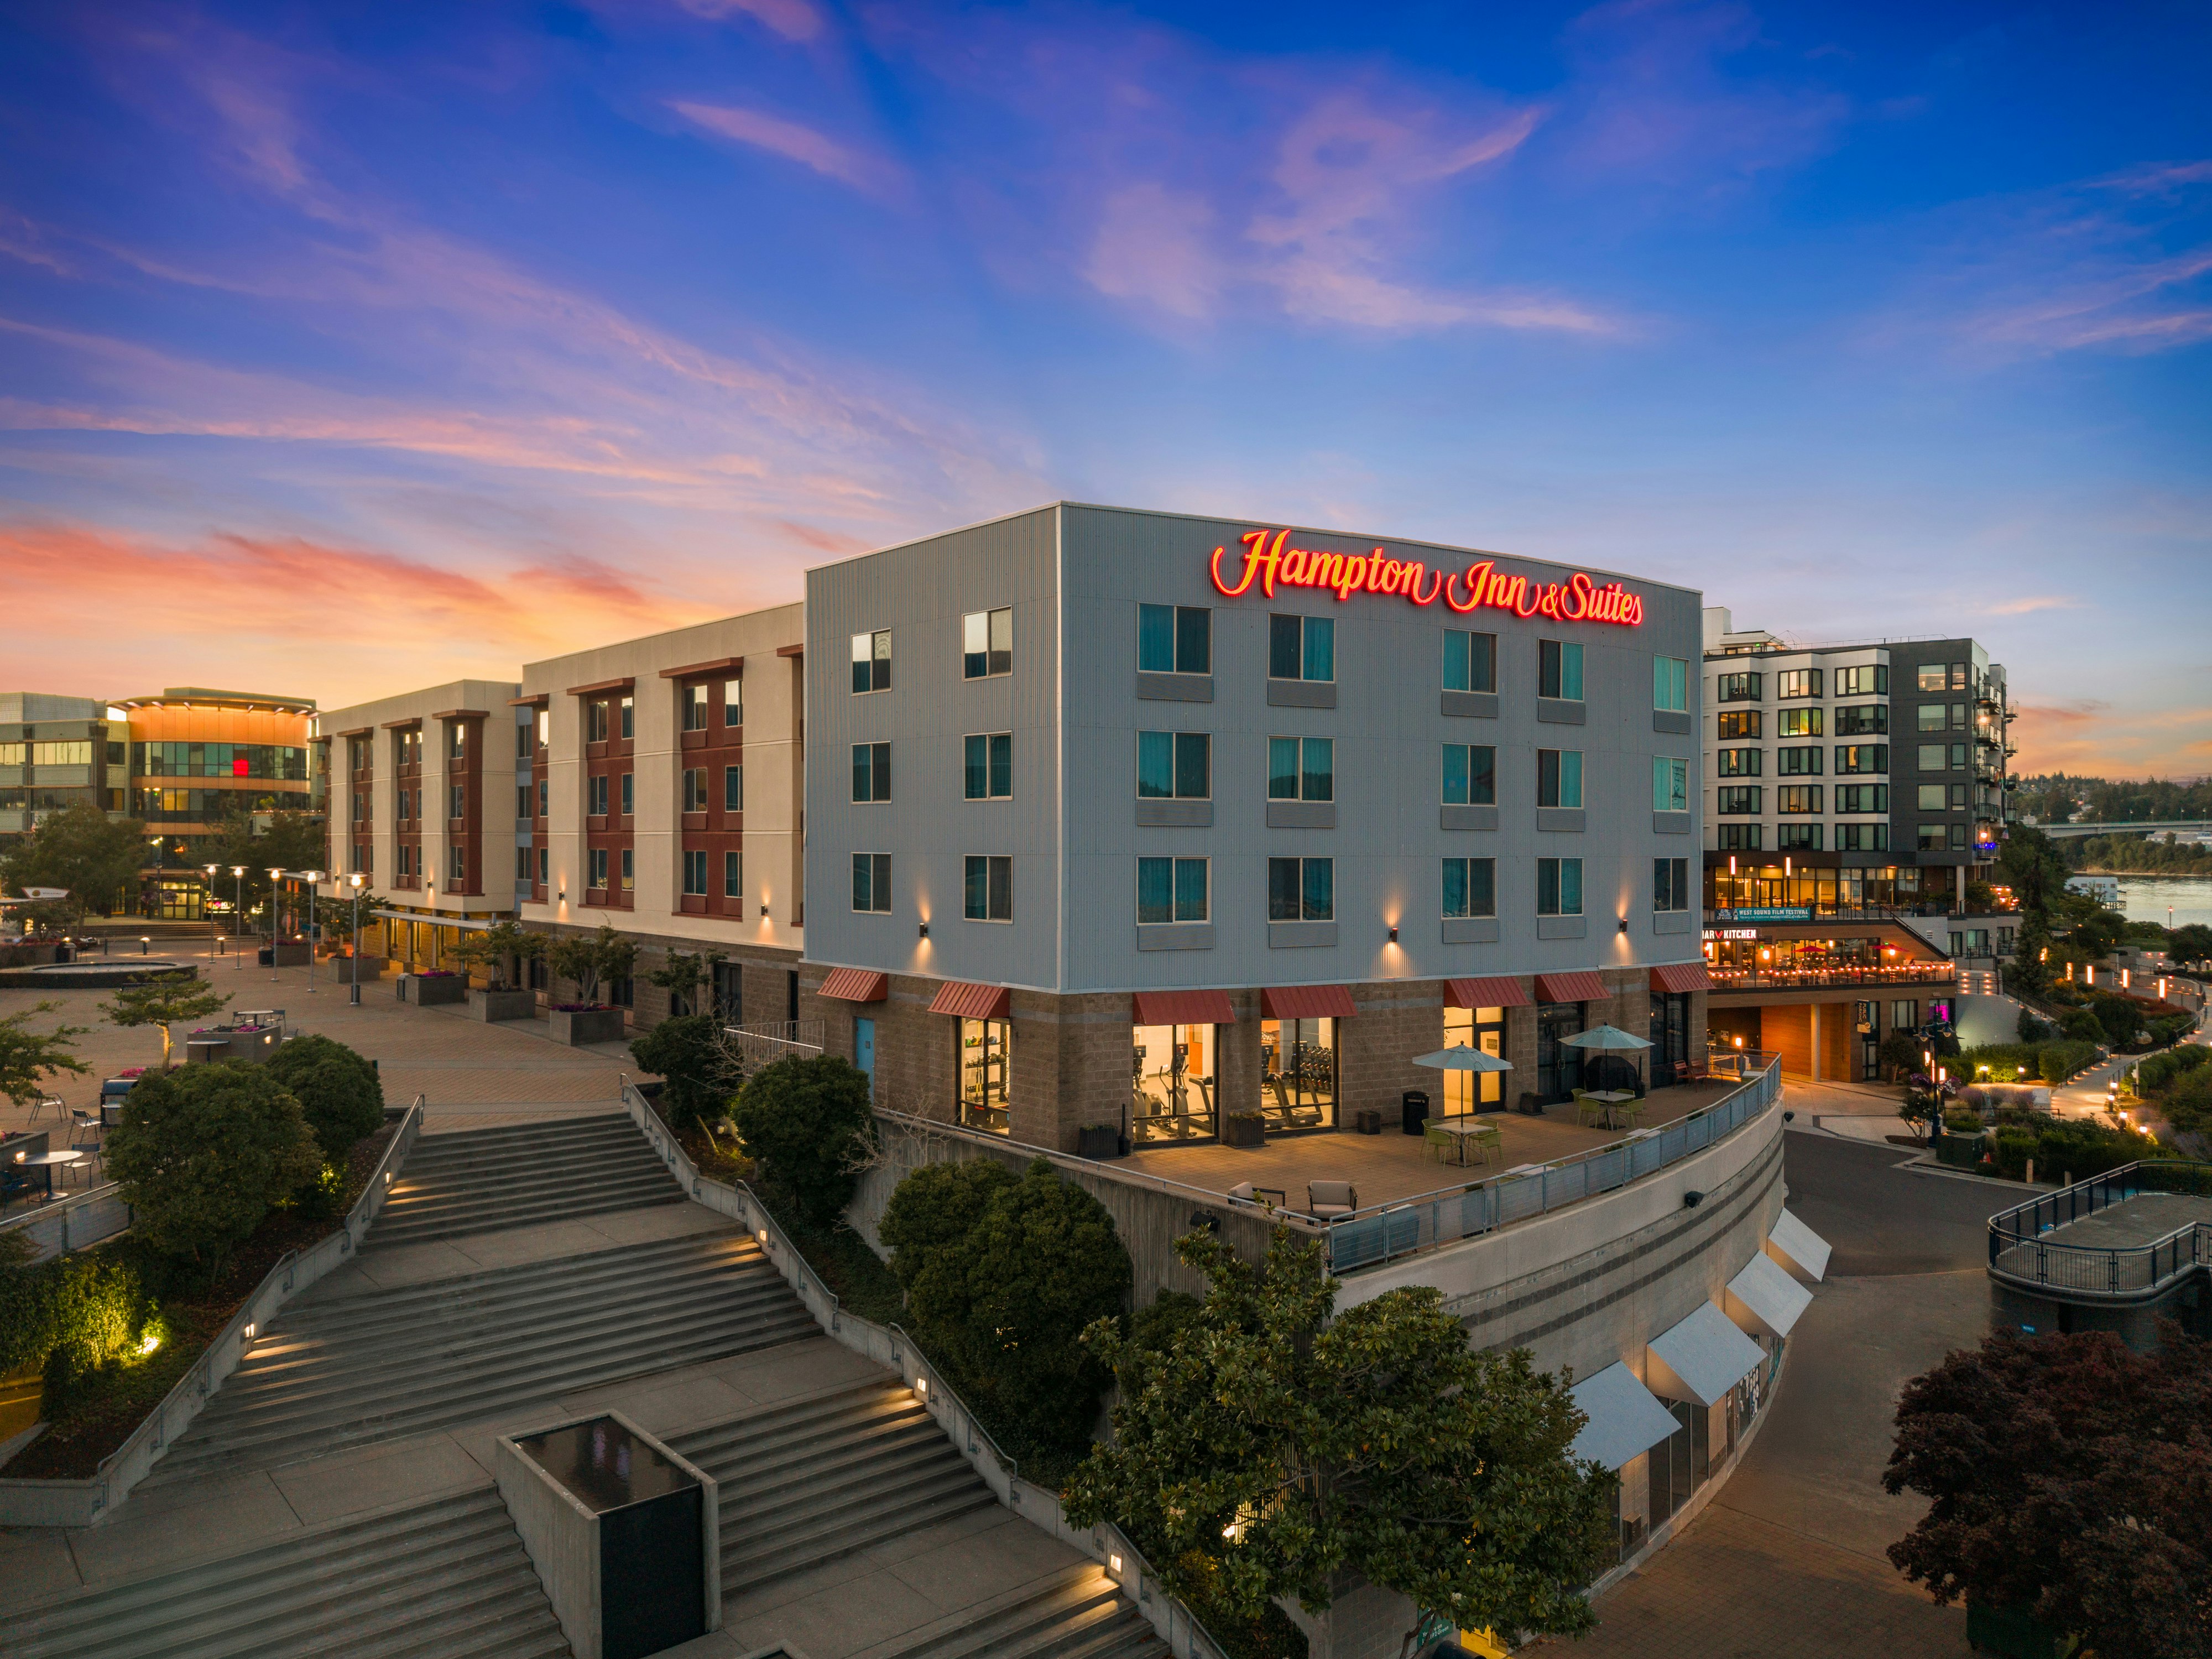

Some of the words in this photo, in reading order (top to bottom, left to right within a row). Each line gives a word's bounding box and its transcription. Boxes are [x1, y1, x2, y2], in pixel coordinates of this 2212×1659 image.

[1211, 529, 1442, 606] Hampton
[1446, 561, 1542, 618] Inn
[1541, 583, 1563, 620] &
[1561, 572, 1644, 625] Suites
[1702, 930, 1714, 939] AR
[1723, 929, 1756, 939] KITCHEN
[1437, 1626, 1449, 1635] Green
